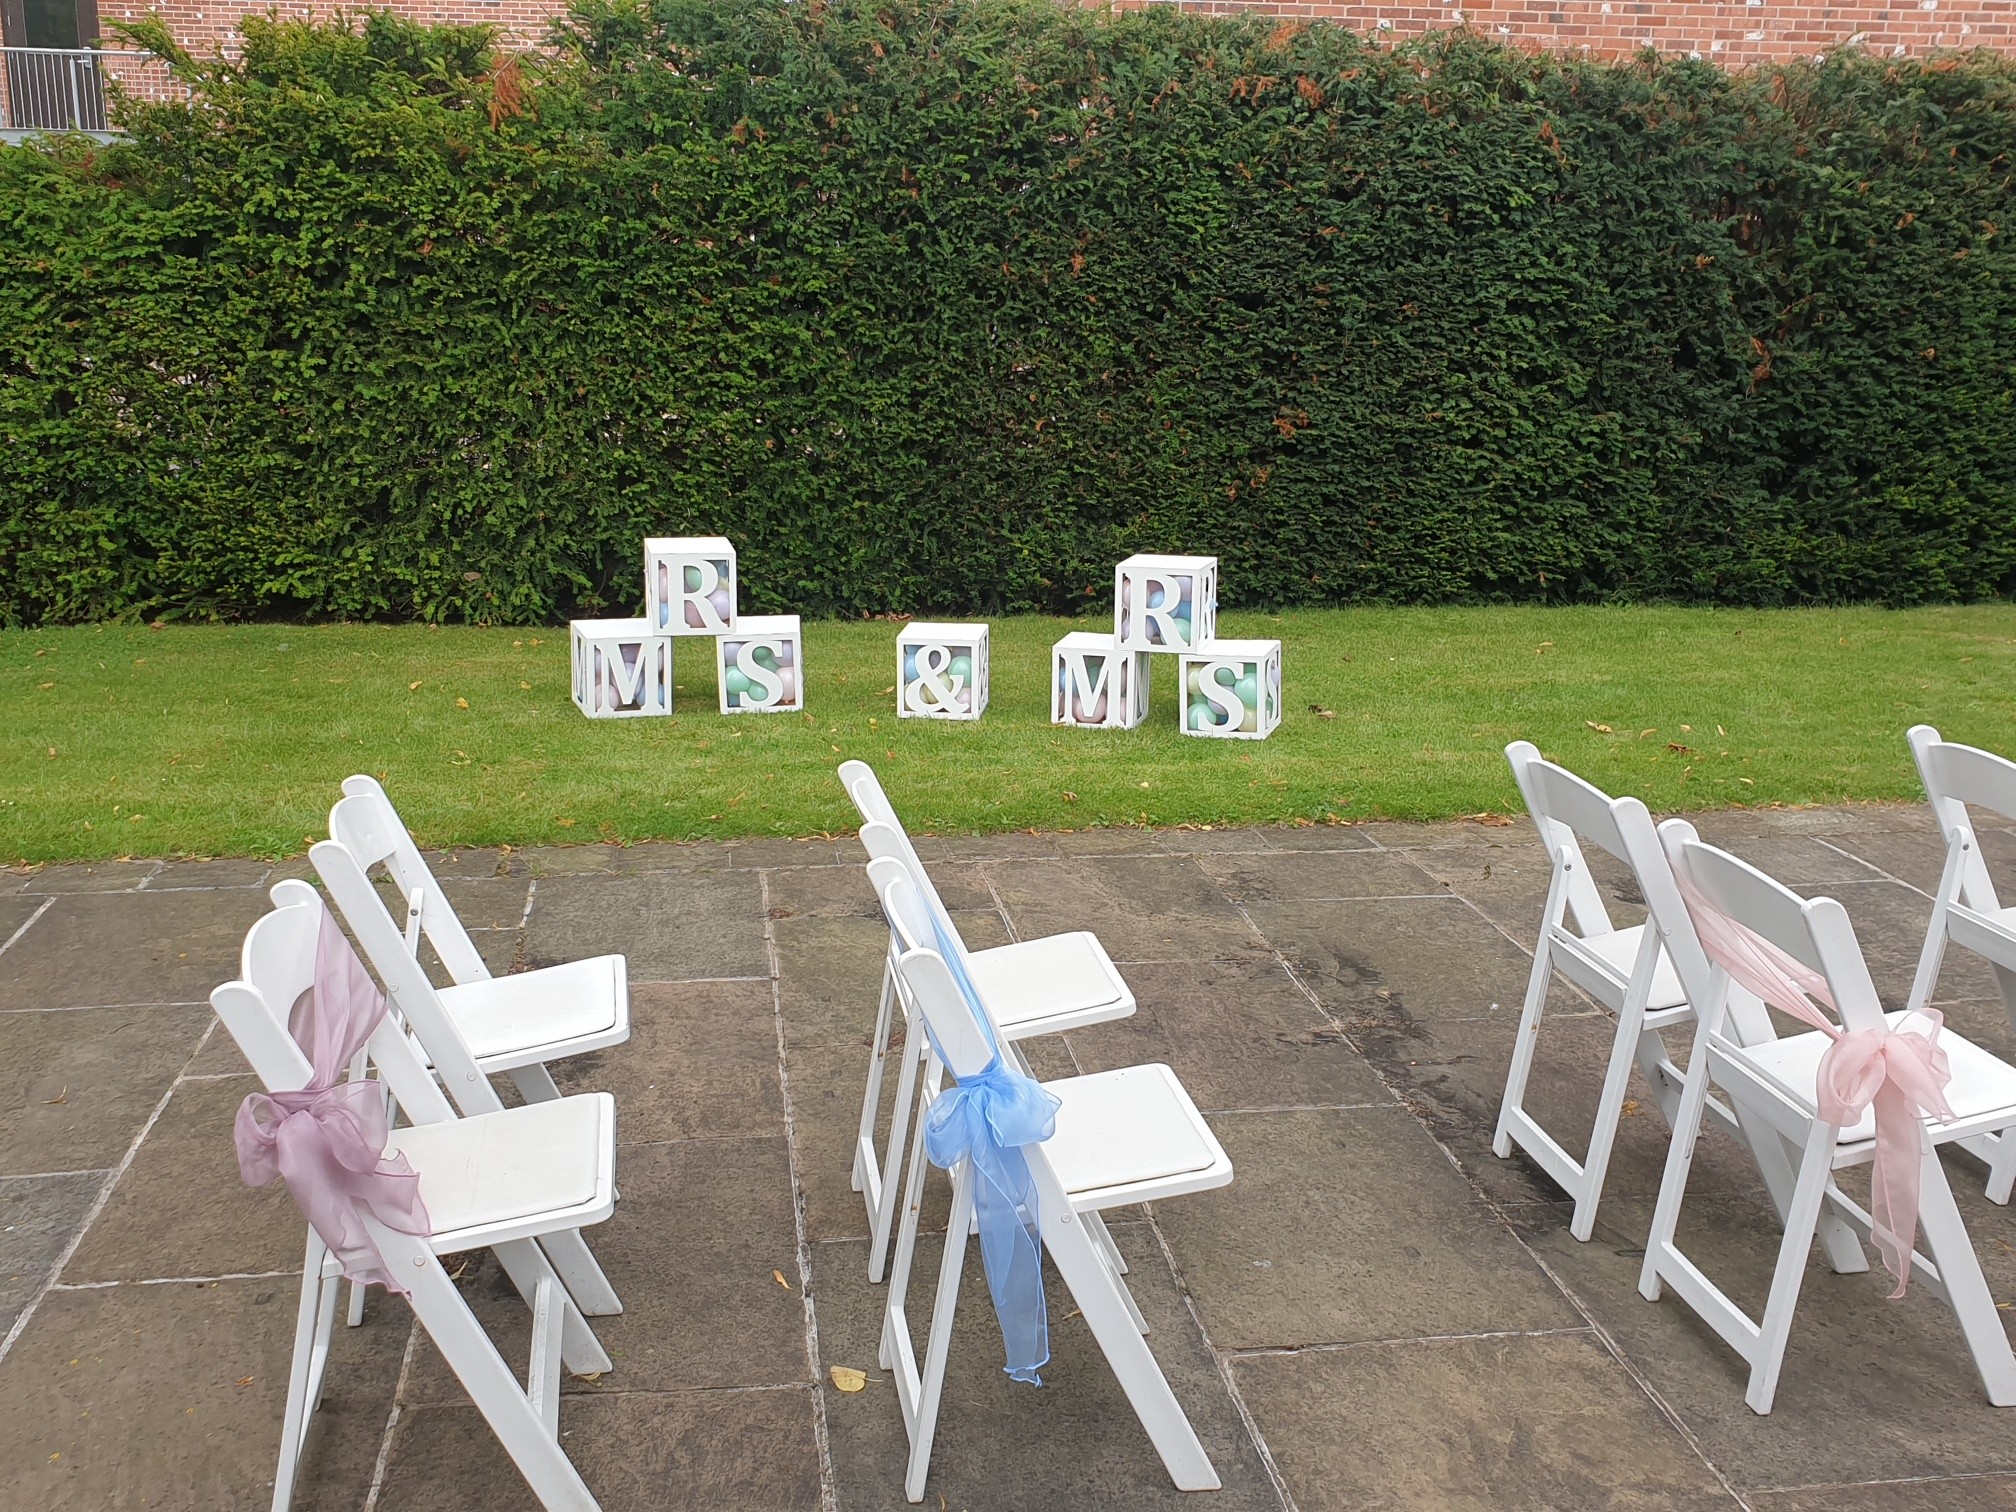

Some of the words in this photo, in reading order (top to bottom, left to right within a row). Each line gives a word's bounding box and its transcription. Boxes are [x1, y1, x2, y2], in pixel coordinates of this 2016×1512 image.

[660, 558, 730, 629] R
[1122, 573, 1191, 646] R
[595, 643, 665, 712] M
[737, 640, 784, 707] S
[905, 645, 970, 713] &
[1059, 654, 1128, 724] M
[1198, 661, 1245, 732] S
